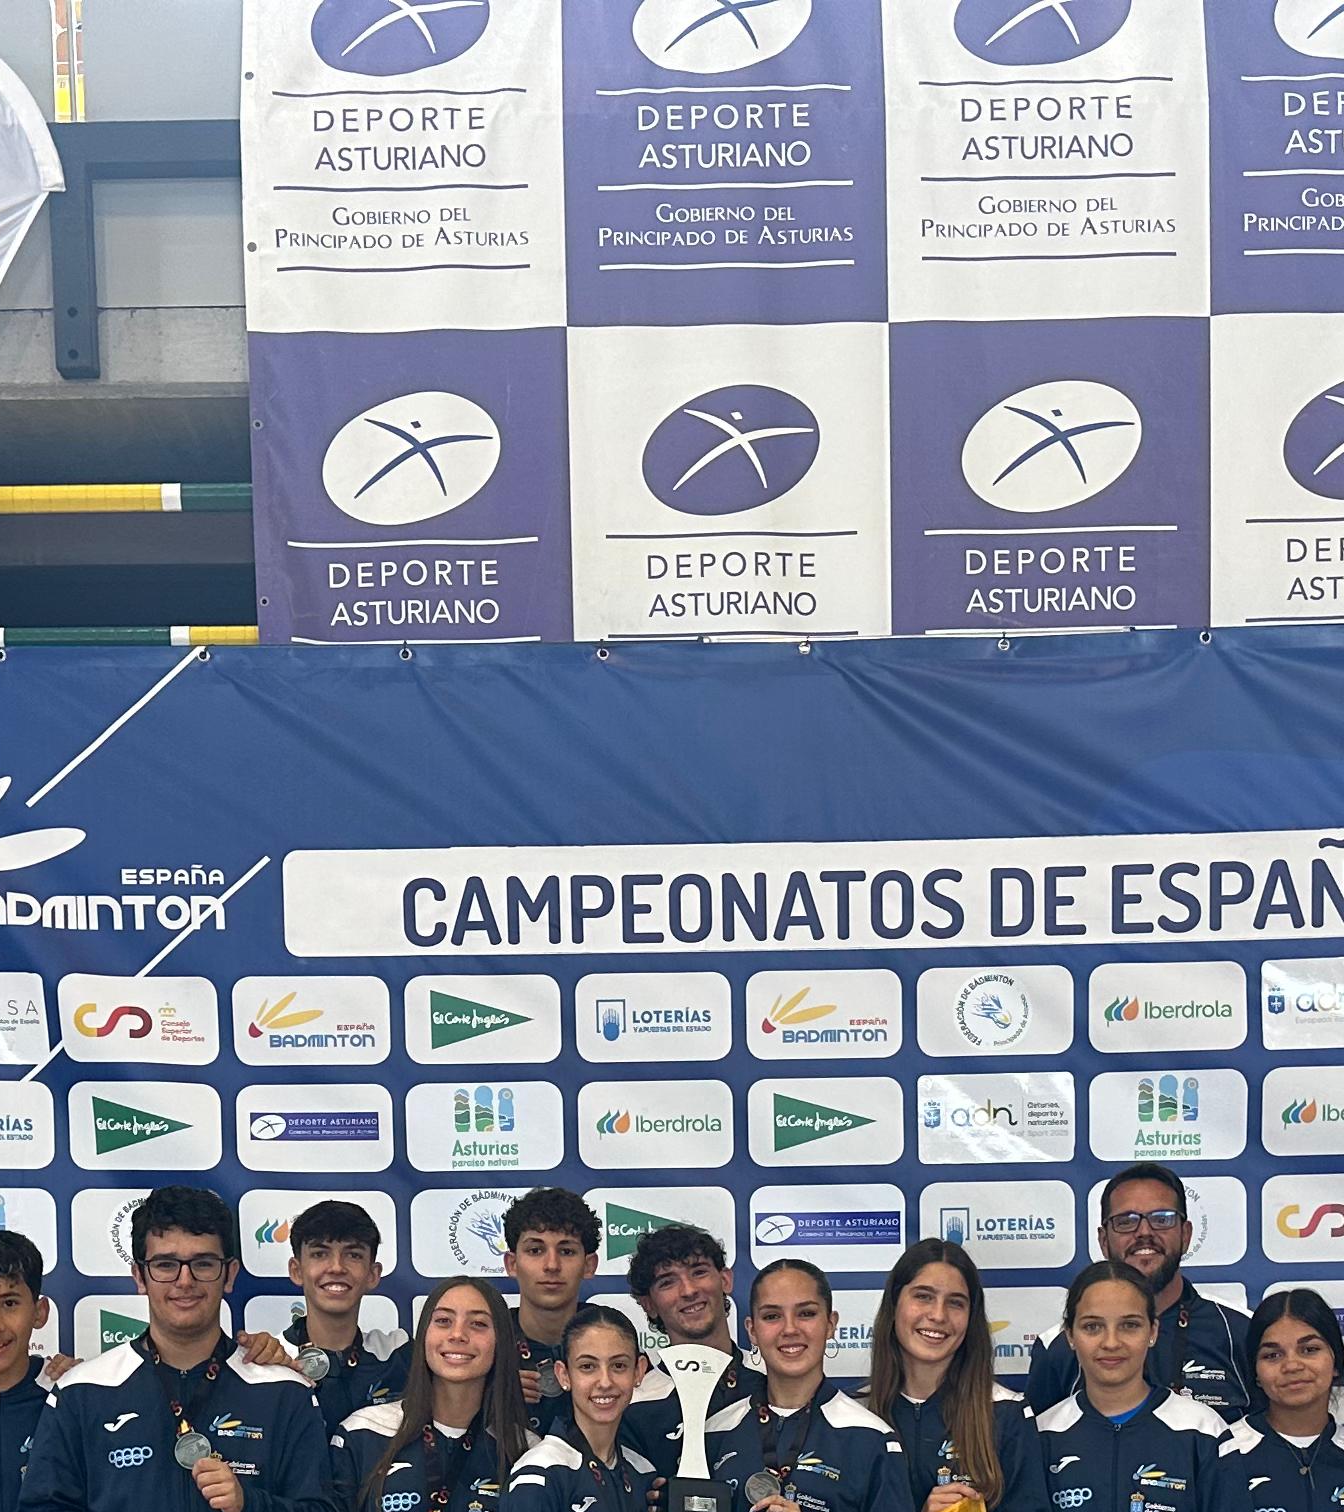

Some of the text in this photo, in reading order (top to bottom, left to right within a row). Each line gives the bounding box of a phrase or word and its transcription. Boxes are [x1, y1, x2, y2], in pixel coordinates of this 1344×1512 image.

[637, 103, 810, 131] DEPORTE
[961, 95, 1133, 122] DEPORTE
[313, 107, 486, 133] DEPORTE
[638, 140, 811, 169] ASTURIANO
[962, 133, 1134, 160] ASTURIANO
[314, 144, 486, 172] ASTURIANO
[646, 552, 818, 581] DEPORTE
[963, 545, 1136, 576] DEPORTE
[327, 559, 499, 588] DEPORTE
[648, 589, 817, 621] ASTURIANO
[967, 583, 1136, 616] ASTURIANO
[329, 596, 500, 628] ASTURIANO
[121, 864, 224, 885] ESPAÑA
[402, 865, 968, 947] CAMPEONATOS
[989, 864, 1087, 939] DE
[444, 1013, 471, 1025] Corte
[632, 1007, 711, 1023] LOTERÍAS
[1144, 1000, 1233, 1020] Iberdrola
[269, 1034, 375, 1047] BADMINTON
[782, 1029, 887, 1043] BADMINTON
[108, 1118, 131, 1130] Corte
[635, 1114, 722, 1133] Iberdrola
[787, 1114, 813, 1128] Corte
[452, 1140, 519, 1156] Asturias
[1135, 1130, 1201, 1146] Asturias
[460, 1199, 472, 1211] DE
[798, 1218, 899, 1228] DEPORTE ASTURIANO
[976, 1214, 1055, 1232] LOTERÍAS
